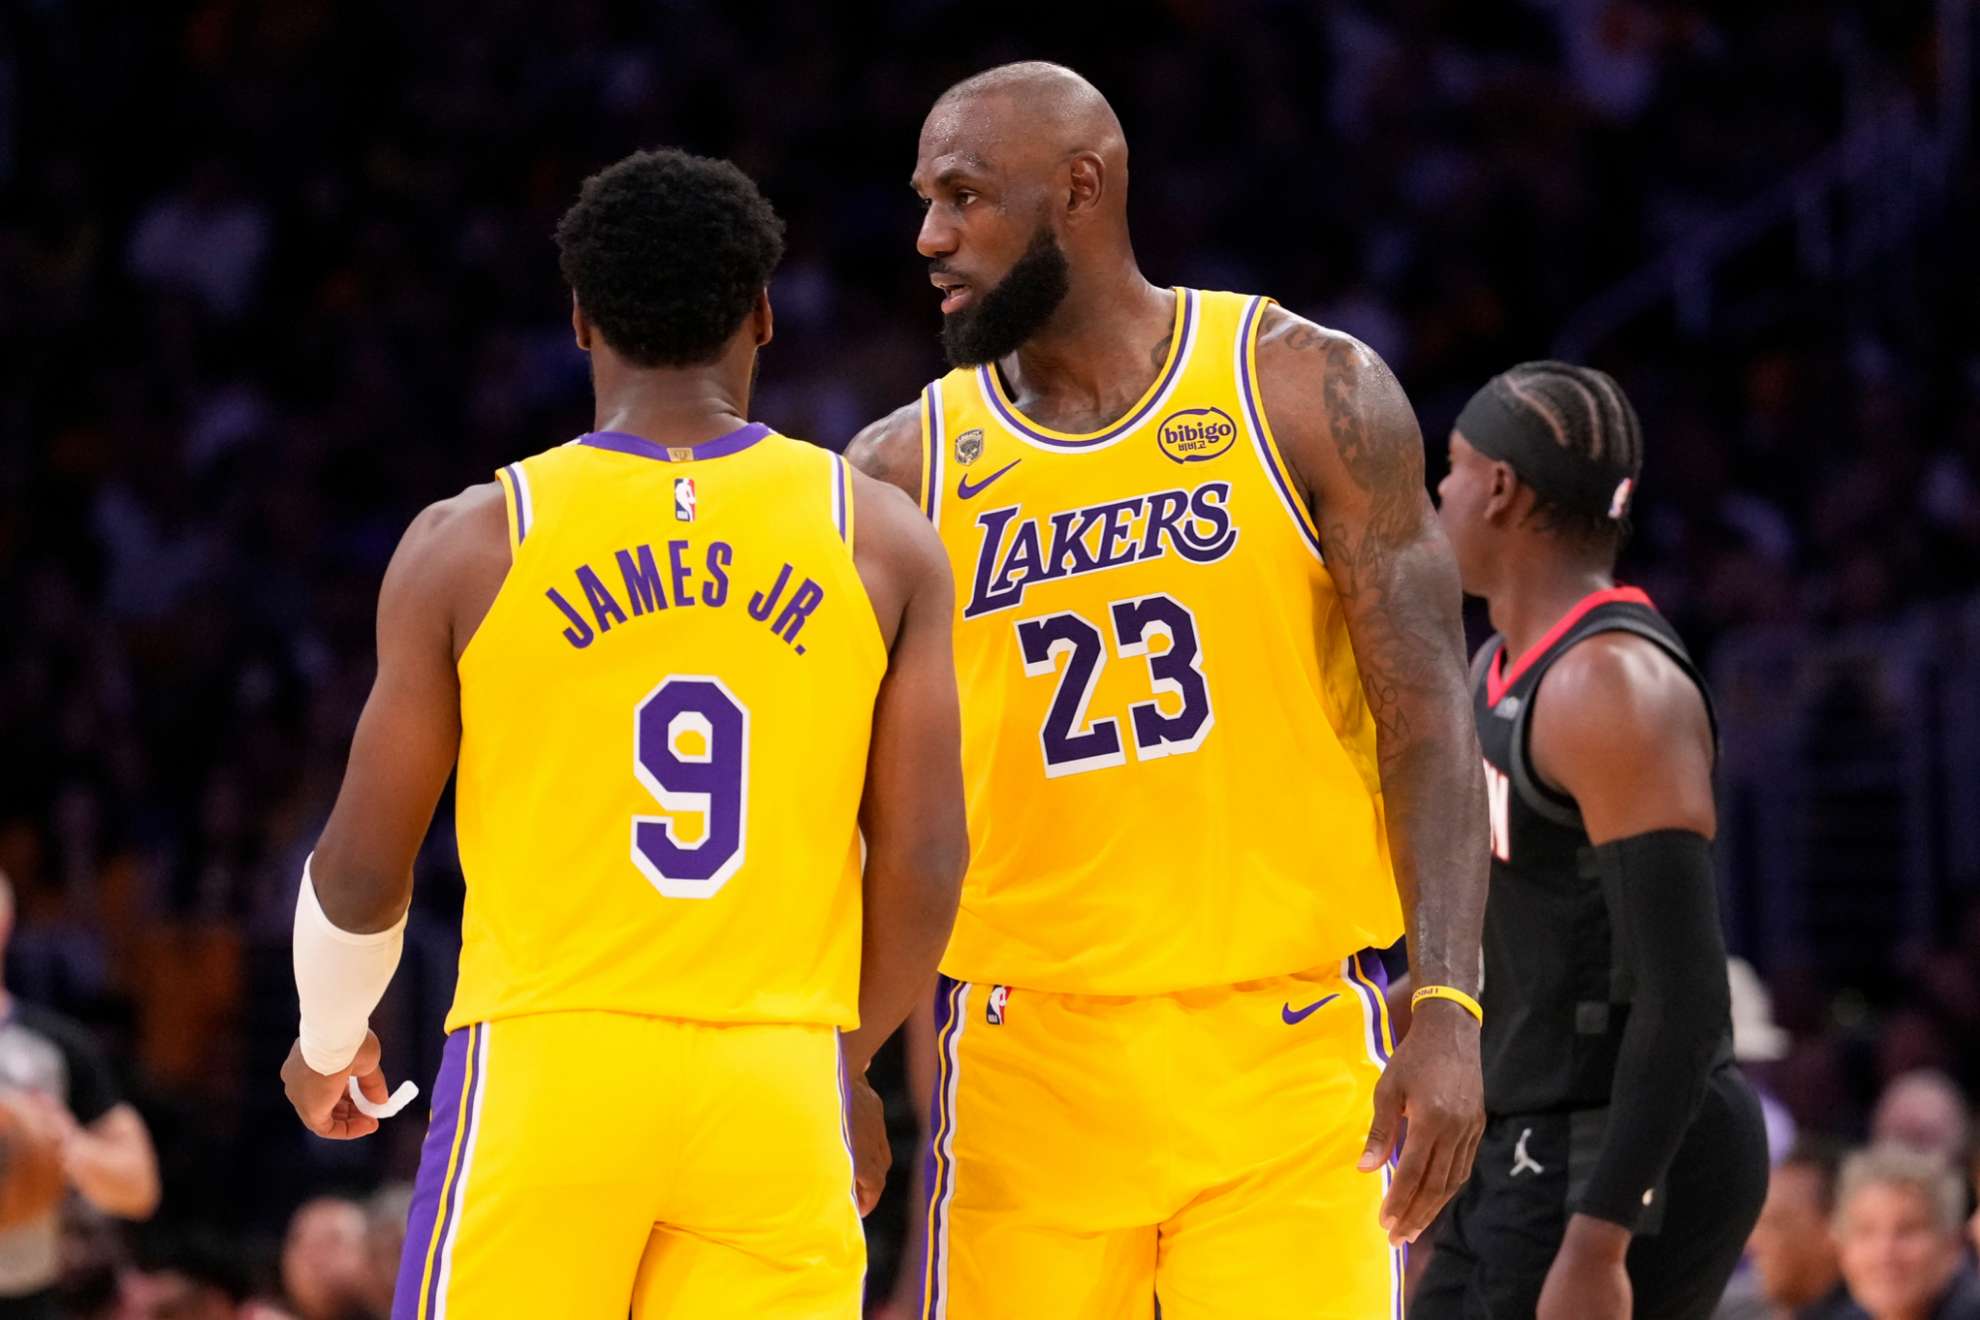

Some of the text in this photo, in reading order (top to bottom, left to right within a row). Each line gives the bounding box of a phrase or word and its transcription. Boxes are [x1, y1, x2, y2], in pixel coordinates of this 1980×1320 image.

[1165, 422, 1232, 443] bibigo
[1178, 440, 1206, 451] 비비고
[545, 540, 824, 656] JAMES JR.
[963, 482, 1240, 619] LAKERS
[1014, 592, 1215, 779] 23
[631, 674, 750, 899] 9
